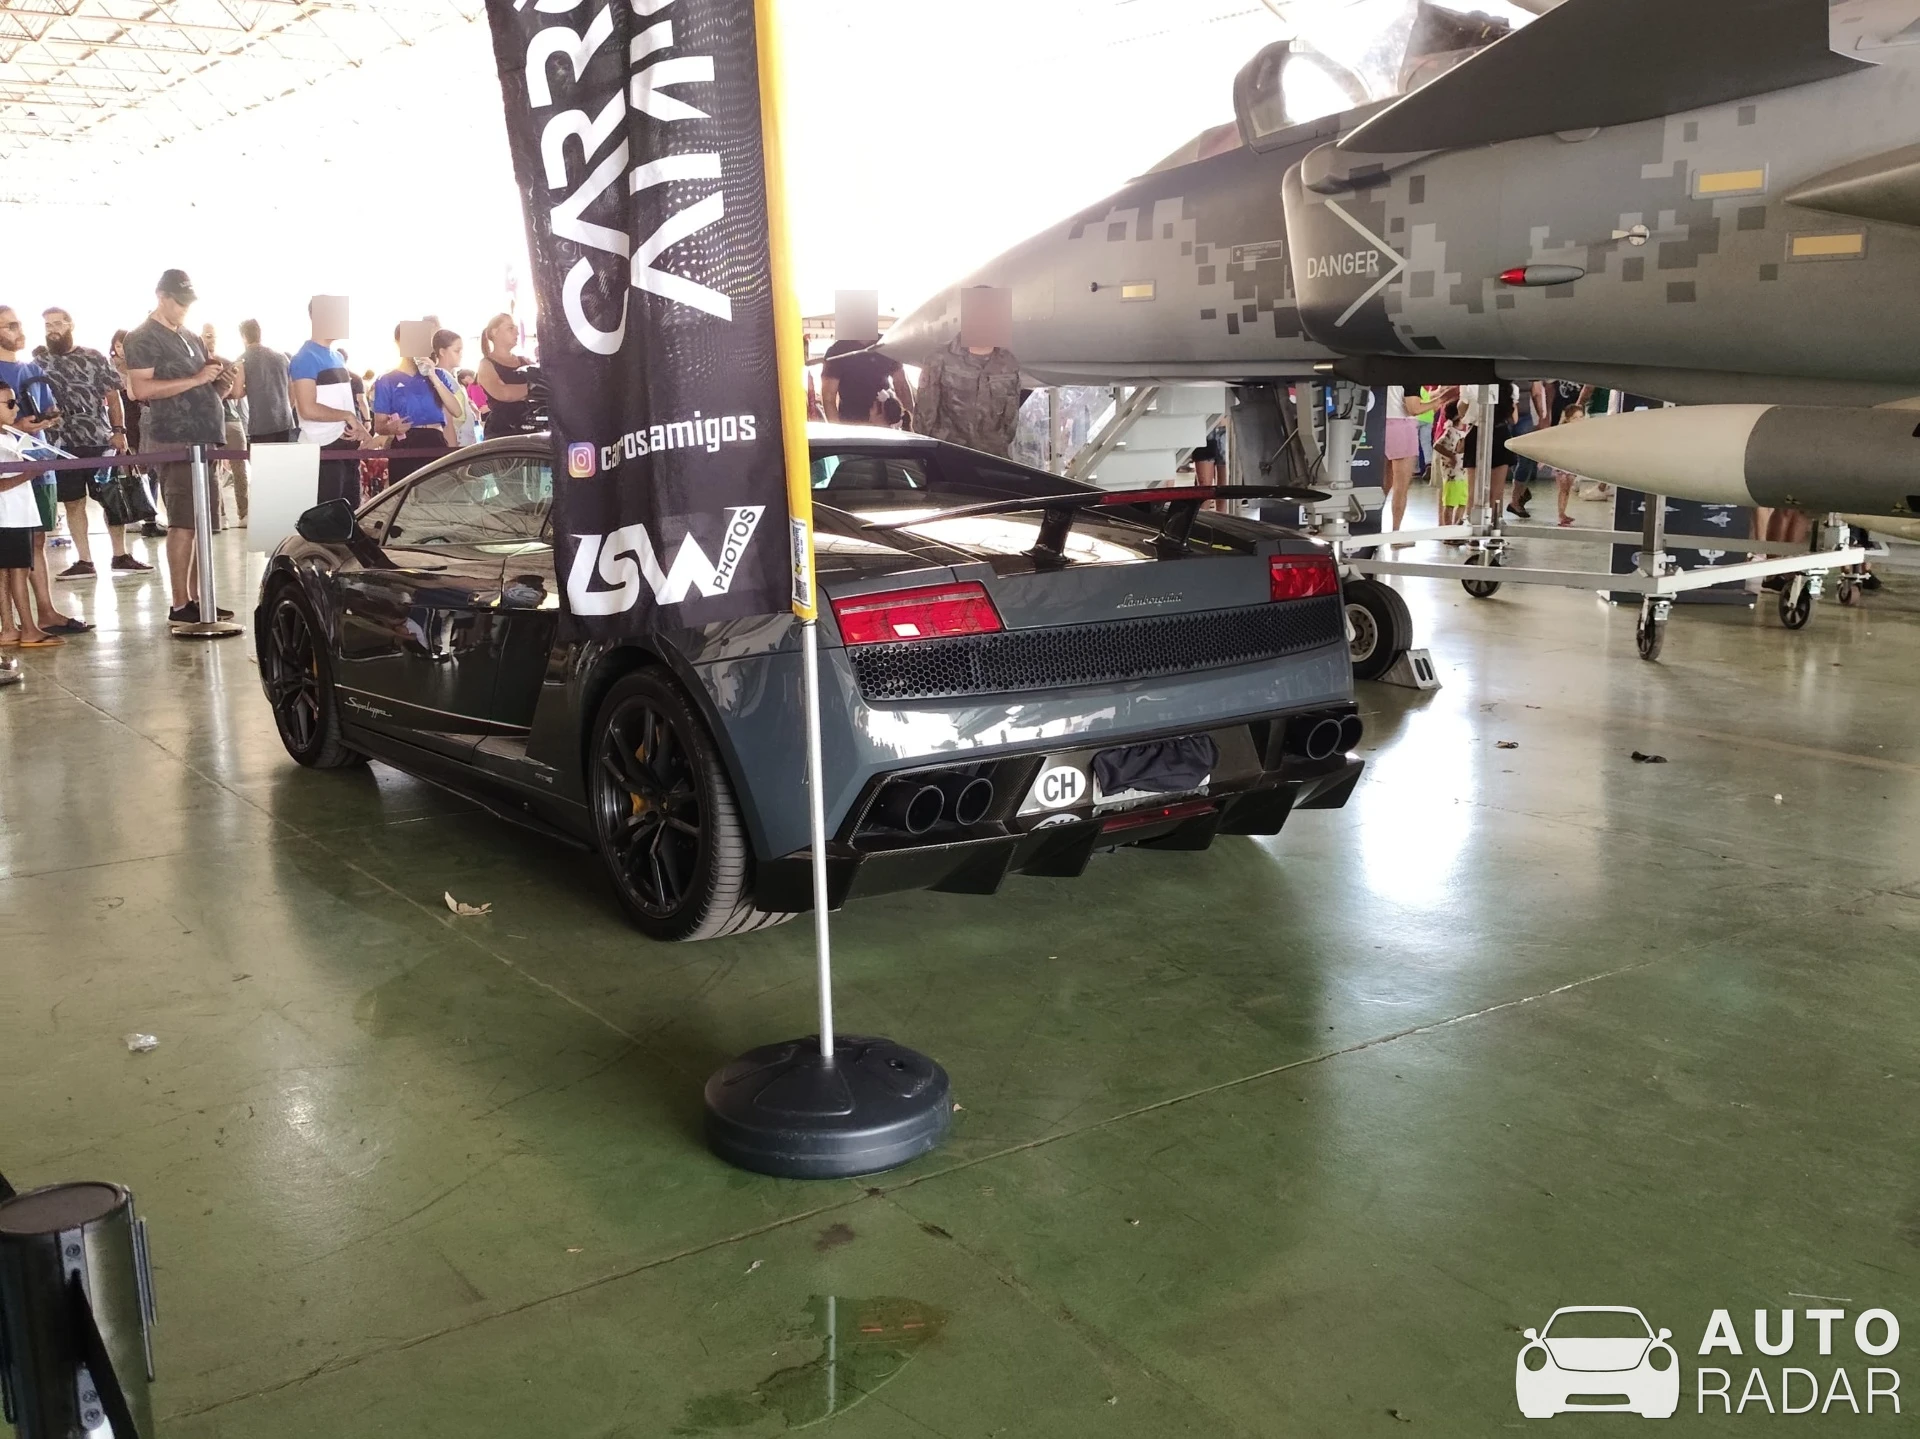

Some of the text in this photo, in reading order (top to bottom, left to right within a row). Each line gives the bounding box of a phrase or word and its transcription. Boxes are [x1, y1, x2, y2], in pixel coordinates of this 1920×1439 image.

[513, 0, 630, 355] CARR
[629, 0, 733, 322] AMI
[1307, 249, 1380, 279] DANGER
[712, 508, 756, 590] PHOTOS
[1042, 771, 1076, 802] CH
